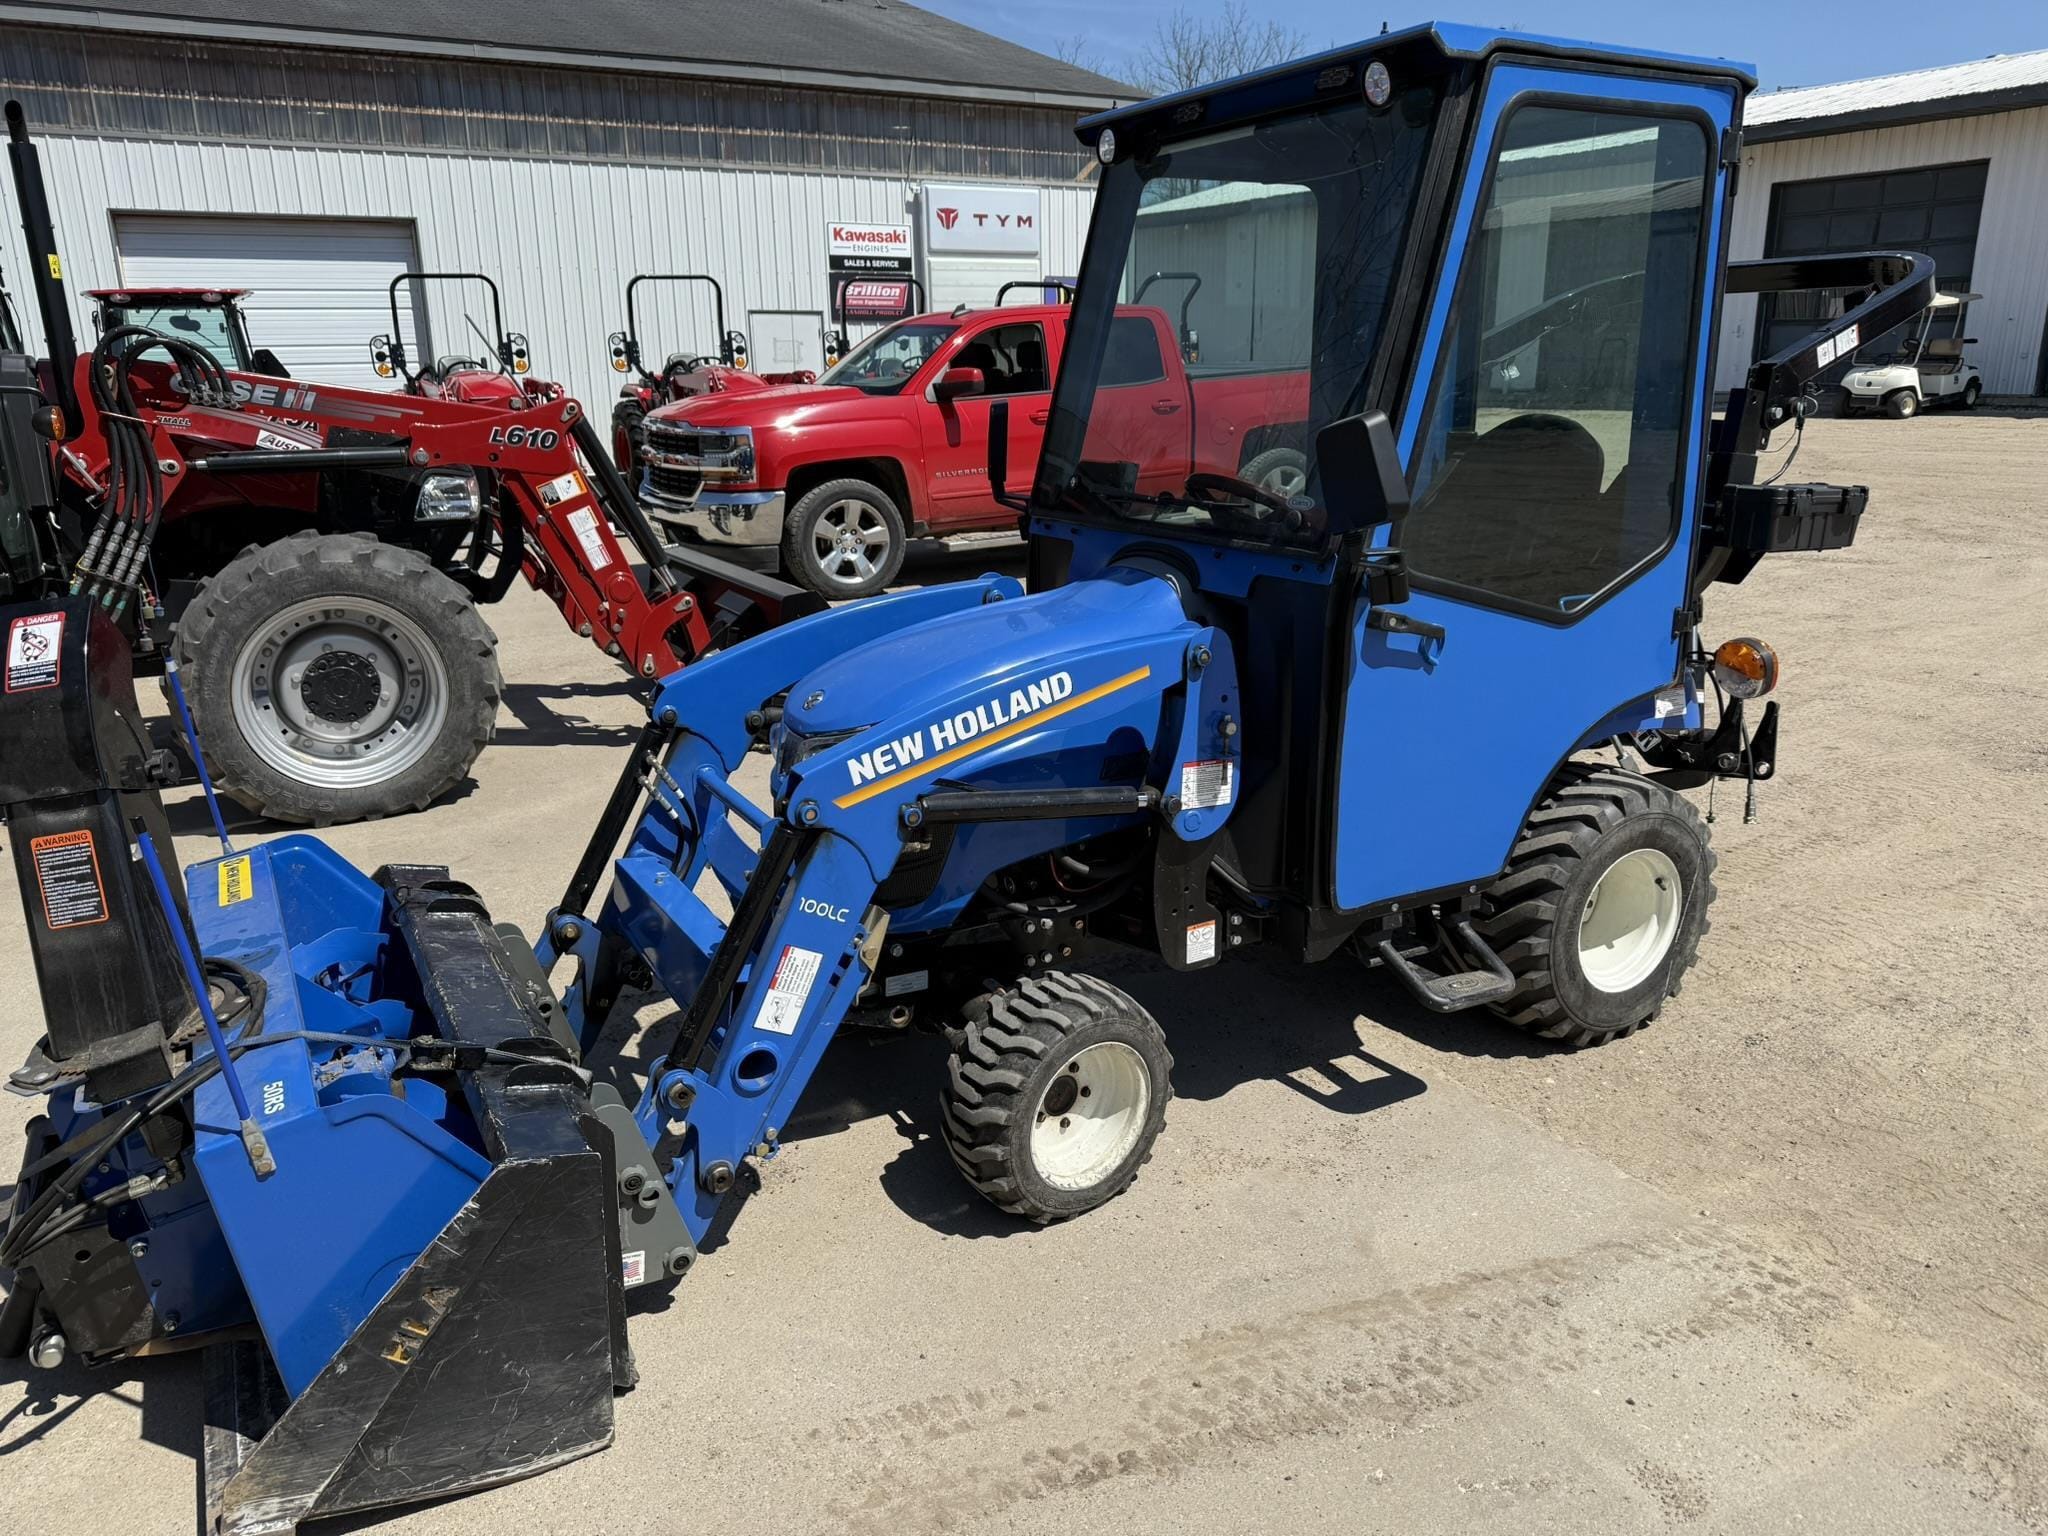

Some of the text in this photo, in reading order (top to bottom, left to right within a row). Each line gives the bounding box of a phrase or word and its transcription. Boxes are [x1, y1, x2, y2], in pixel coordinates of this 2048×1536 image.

[973, 213, 1032, 228] TYM
[833, 227, 907, 243] Kawasaki
[852, 244, 889, 253] ENGINES
[844, 259, 900, 268] SALES & SERVICE
[846, 285, 900, 296] Brillion
[169, 372, 280, 405] CSE
[489, 425, 558, 451] L610
[27, 614, 59, 625] DANGER
[847, 671, 1073, 786] NEW HOLLAND
[42, 832, 88, 846] WARNING
[800, 897, 849, 922] 100LC
[264, 1080, 284, 1114] 50RS
